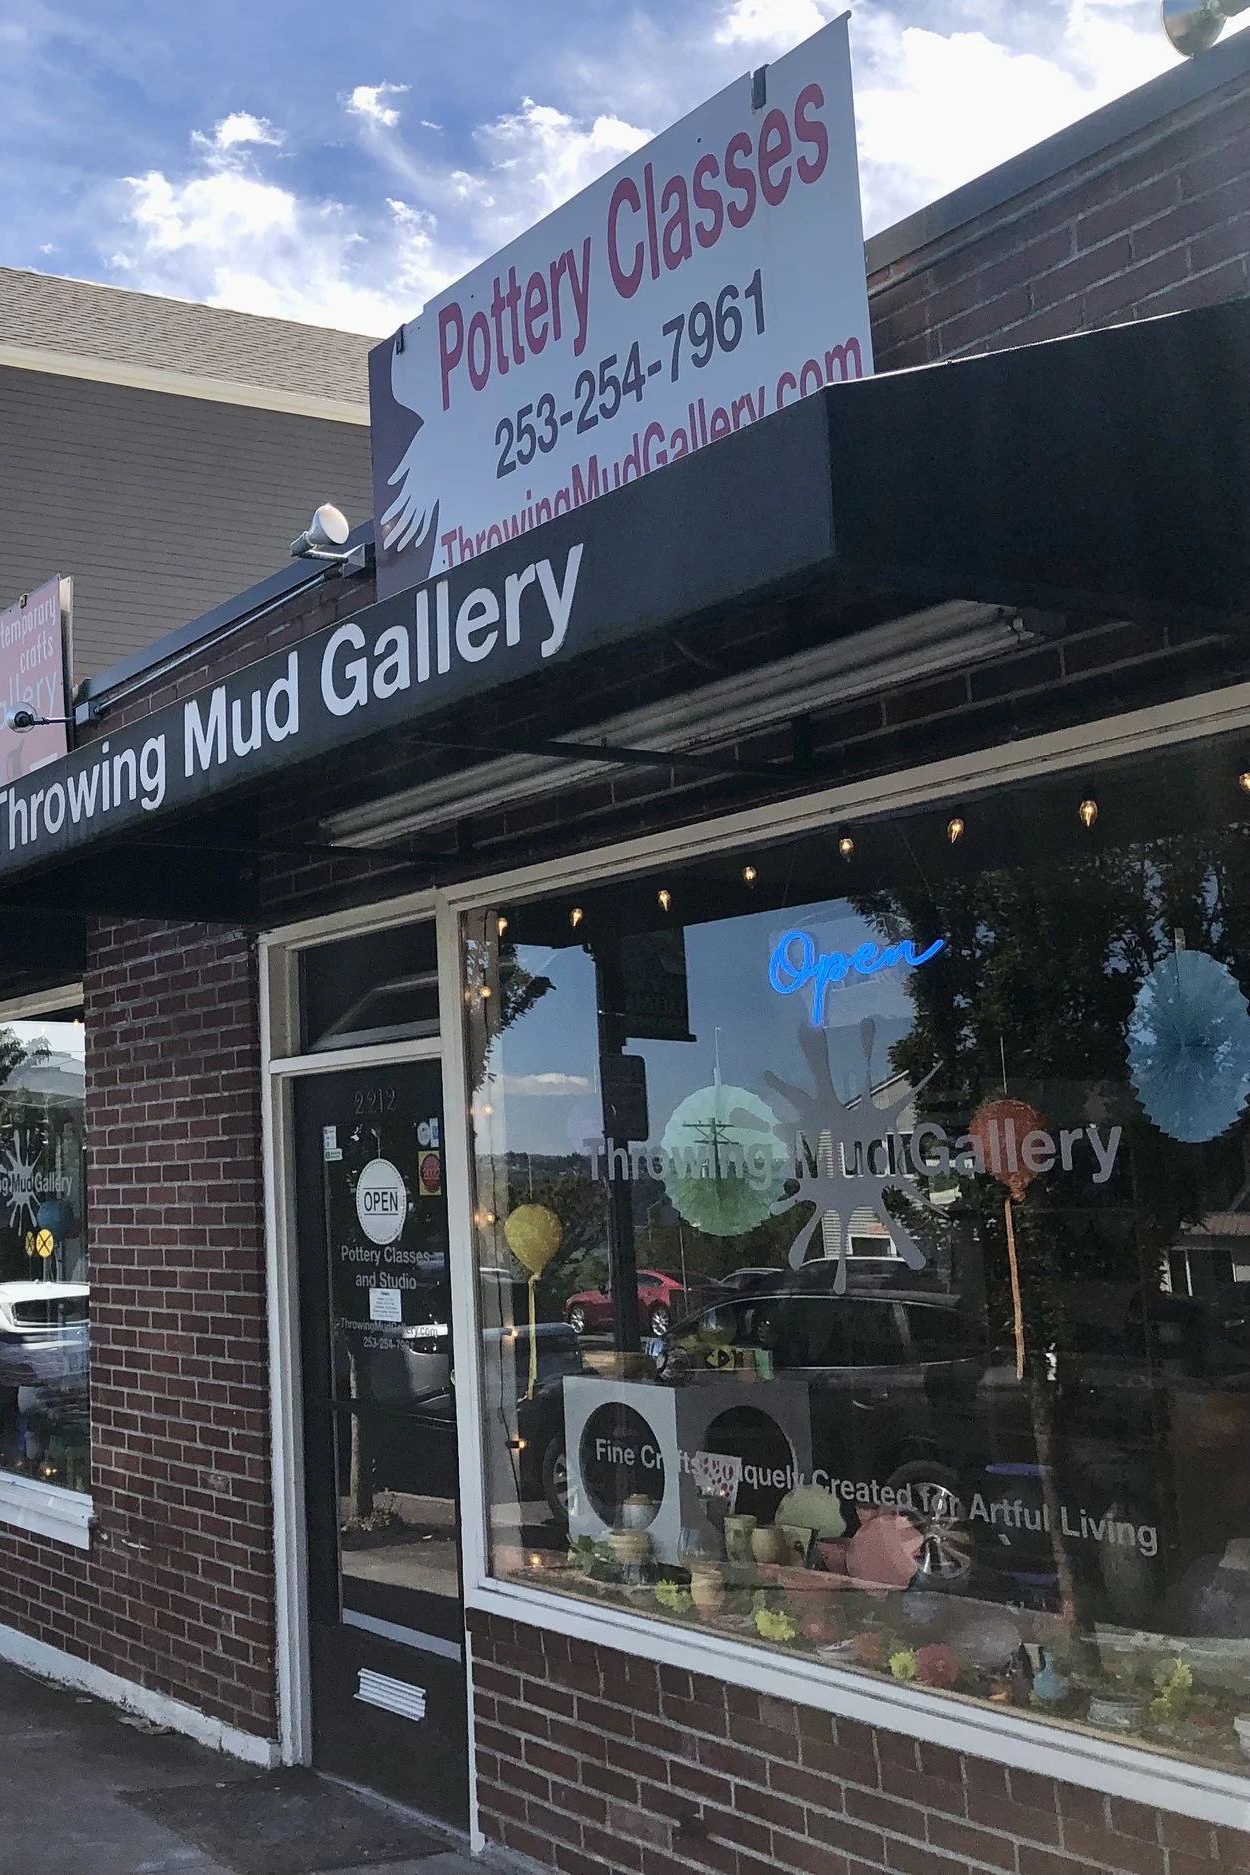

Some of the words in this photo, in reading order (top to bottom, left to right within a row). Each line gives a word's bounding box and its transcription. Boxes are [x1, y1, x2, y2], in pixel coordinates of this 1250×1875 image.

[438, 237, 591, 411] Pottery
[607, 83, 830, 299] Classes
[495, 269, 767, 480] 253-254-7961
[441, 336, 863, 568] ThrowingMudGallerycom
[20, 631, 54, 675] crafts
[183, 653, 299, 777] Mud
[320, 543, 584, 717] Gallery
[768, 929, 946, 1030] Open
[354, 1087, 397, 1115] 2212
[34, 1171, 73, 1197] Gallery
[582, 1137, 773, 1191] Throwing
[794, 1127, 900, 1180] Mud
[910, 1117, 1123, 1184] Gallery
[363, 1190, 399, 1212] OPEN
[341, 1245, 381, 1266] Pottery
[383, 1246, 430, 1264] Classes
[355, 1271, 376, 1287] and
[379, 1271, 417, 1290] Studio
[595, 1438, 635, 1466] Fine
[812, 1469, 913, 1507] Created
[922, 1488, 962, 1516] for
[968, 1492, 1050, 1532] Artful
[1060, 1505, 1159, 1557] Living
